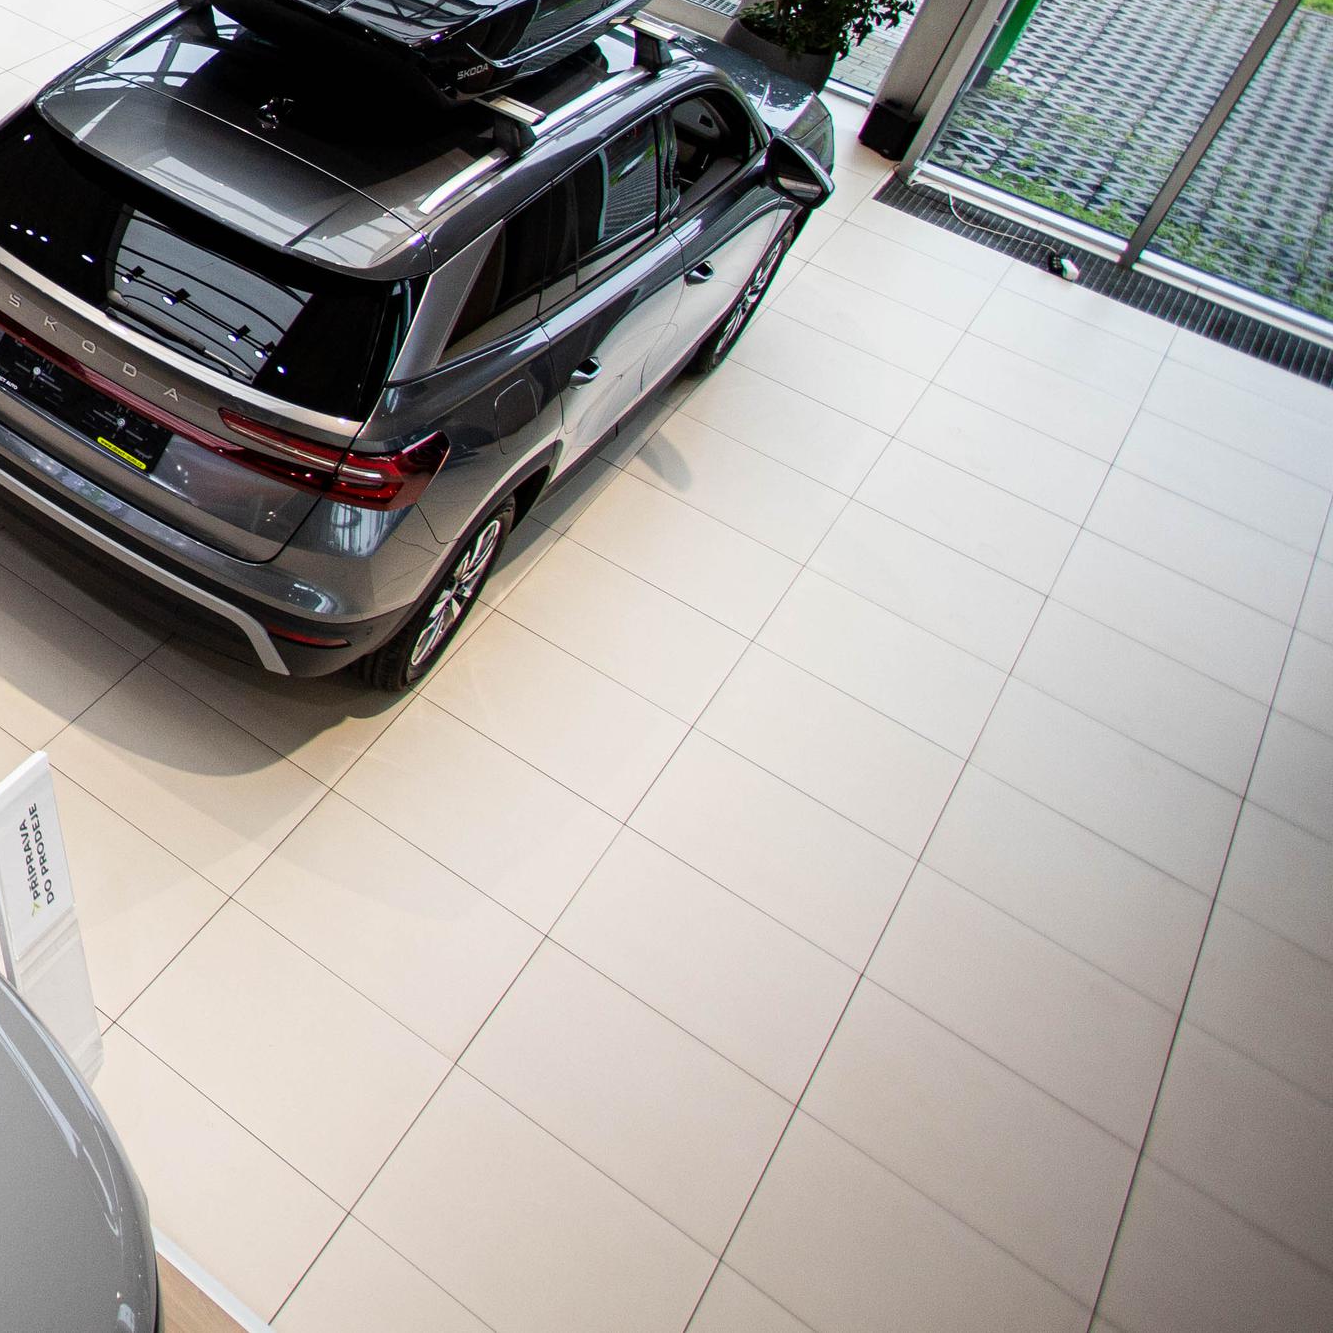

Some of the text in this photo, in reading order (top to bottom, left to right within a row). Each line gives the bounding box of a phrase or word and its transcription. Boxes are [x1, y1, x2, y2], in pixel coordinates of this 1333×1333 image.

[6, 380, 18, 390] AUTO
[19, 819, 41, 900] PŘÍPRAVA
[28, 803, 55, 904] DO PRODEJE
